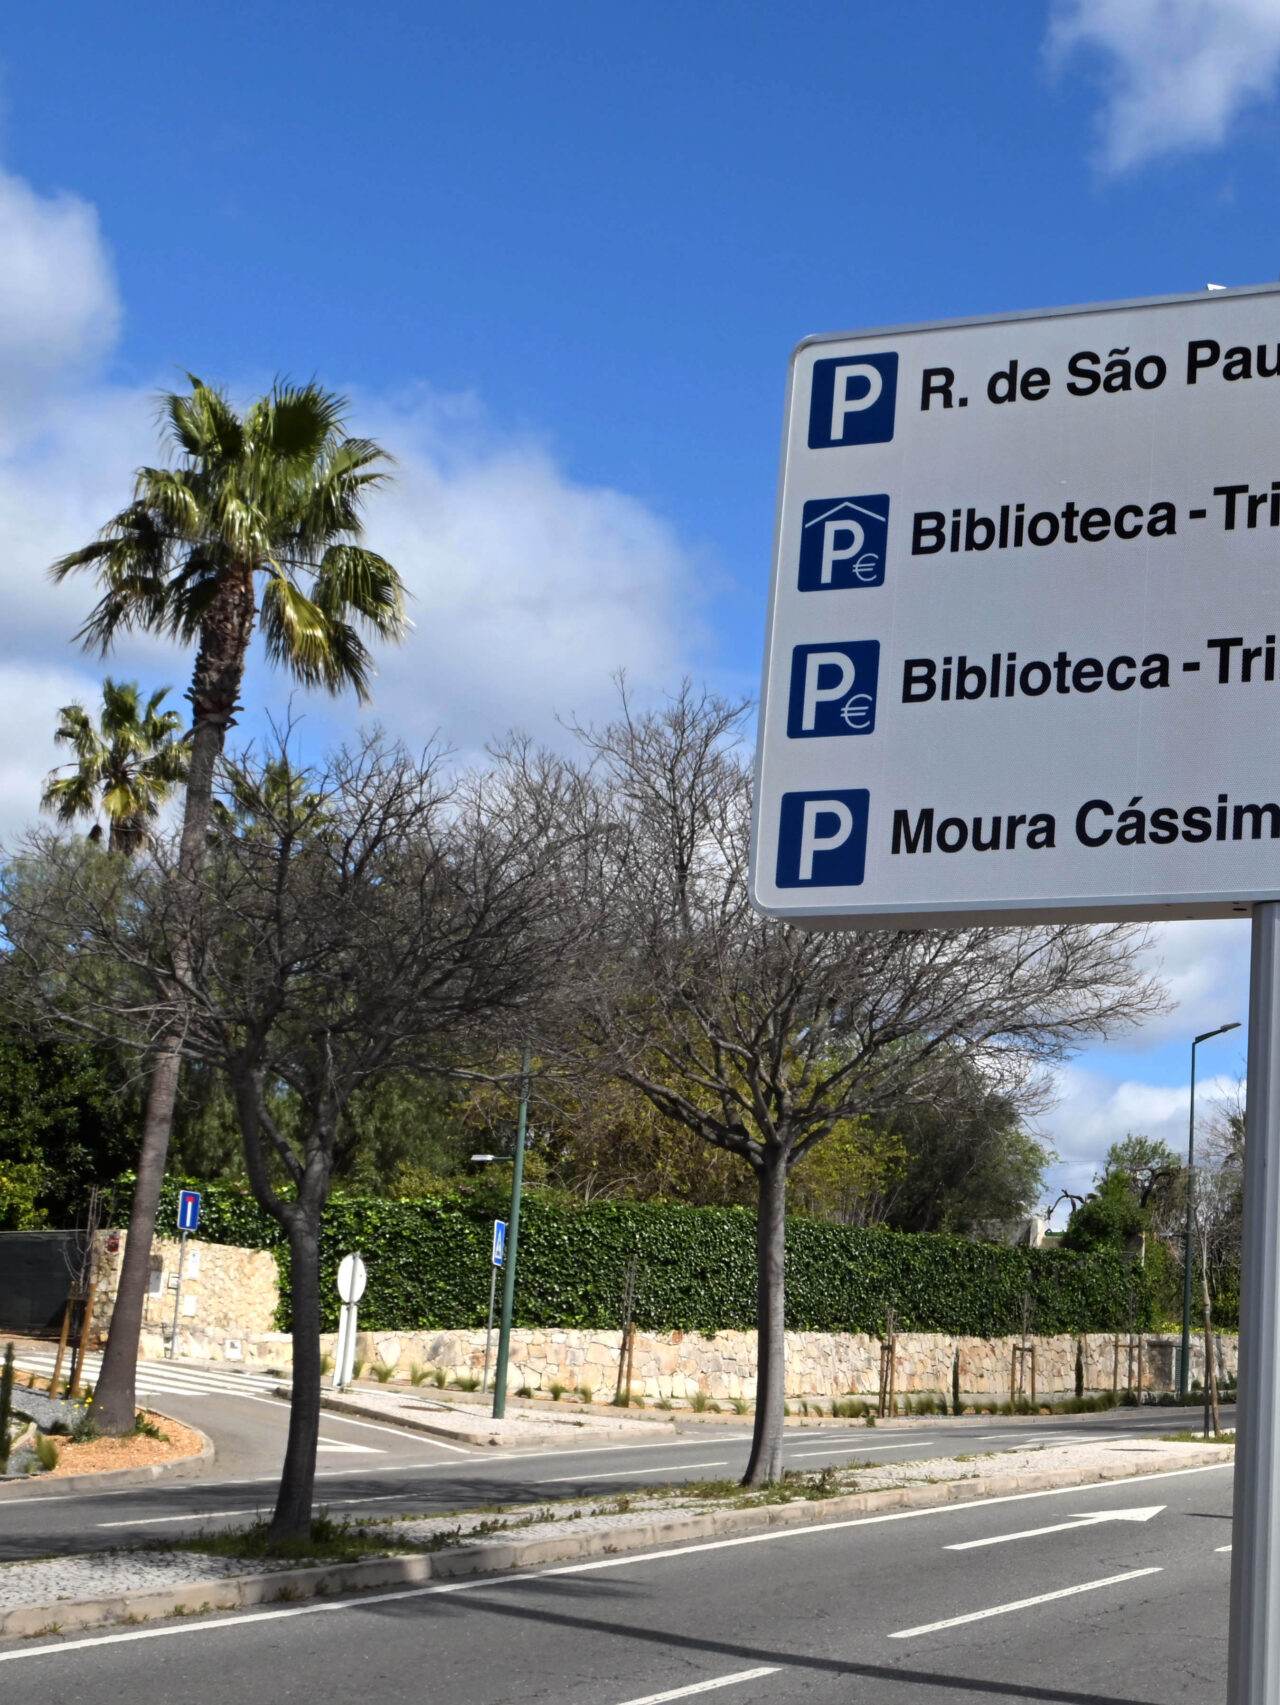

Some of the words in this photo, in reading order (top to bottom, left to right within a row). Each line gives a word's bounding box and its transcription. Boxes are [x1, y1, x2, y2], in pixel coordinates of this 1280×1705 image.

[920, 367, 968, 411] R.
[987, 359, 1051, 405] de
[1066, 346, 1167, 397] São
[911, 501, 1177, 556] Biblioteca
[901, 651, 1170, 704] Biblioteca
[891, 808, 1056, 855] Moura
